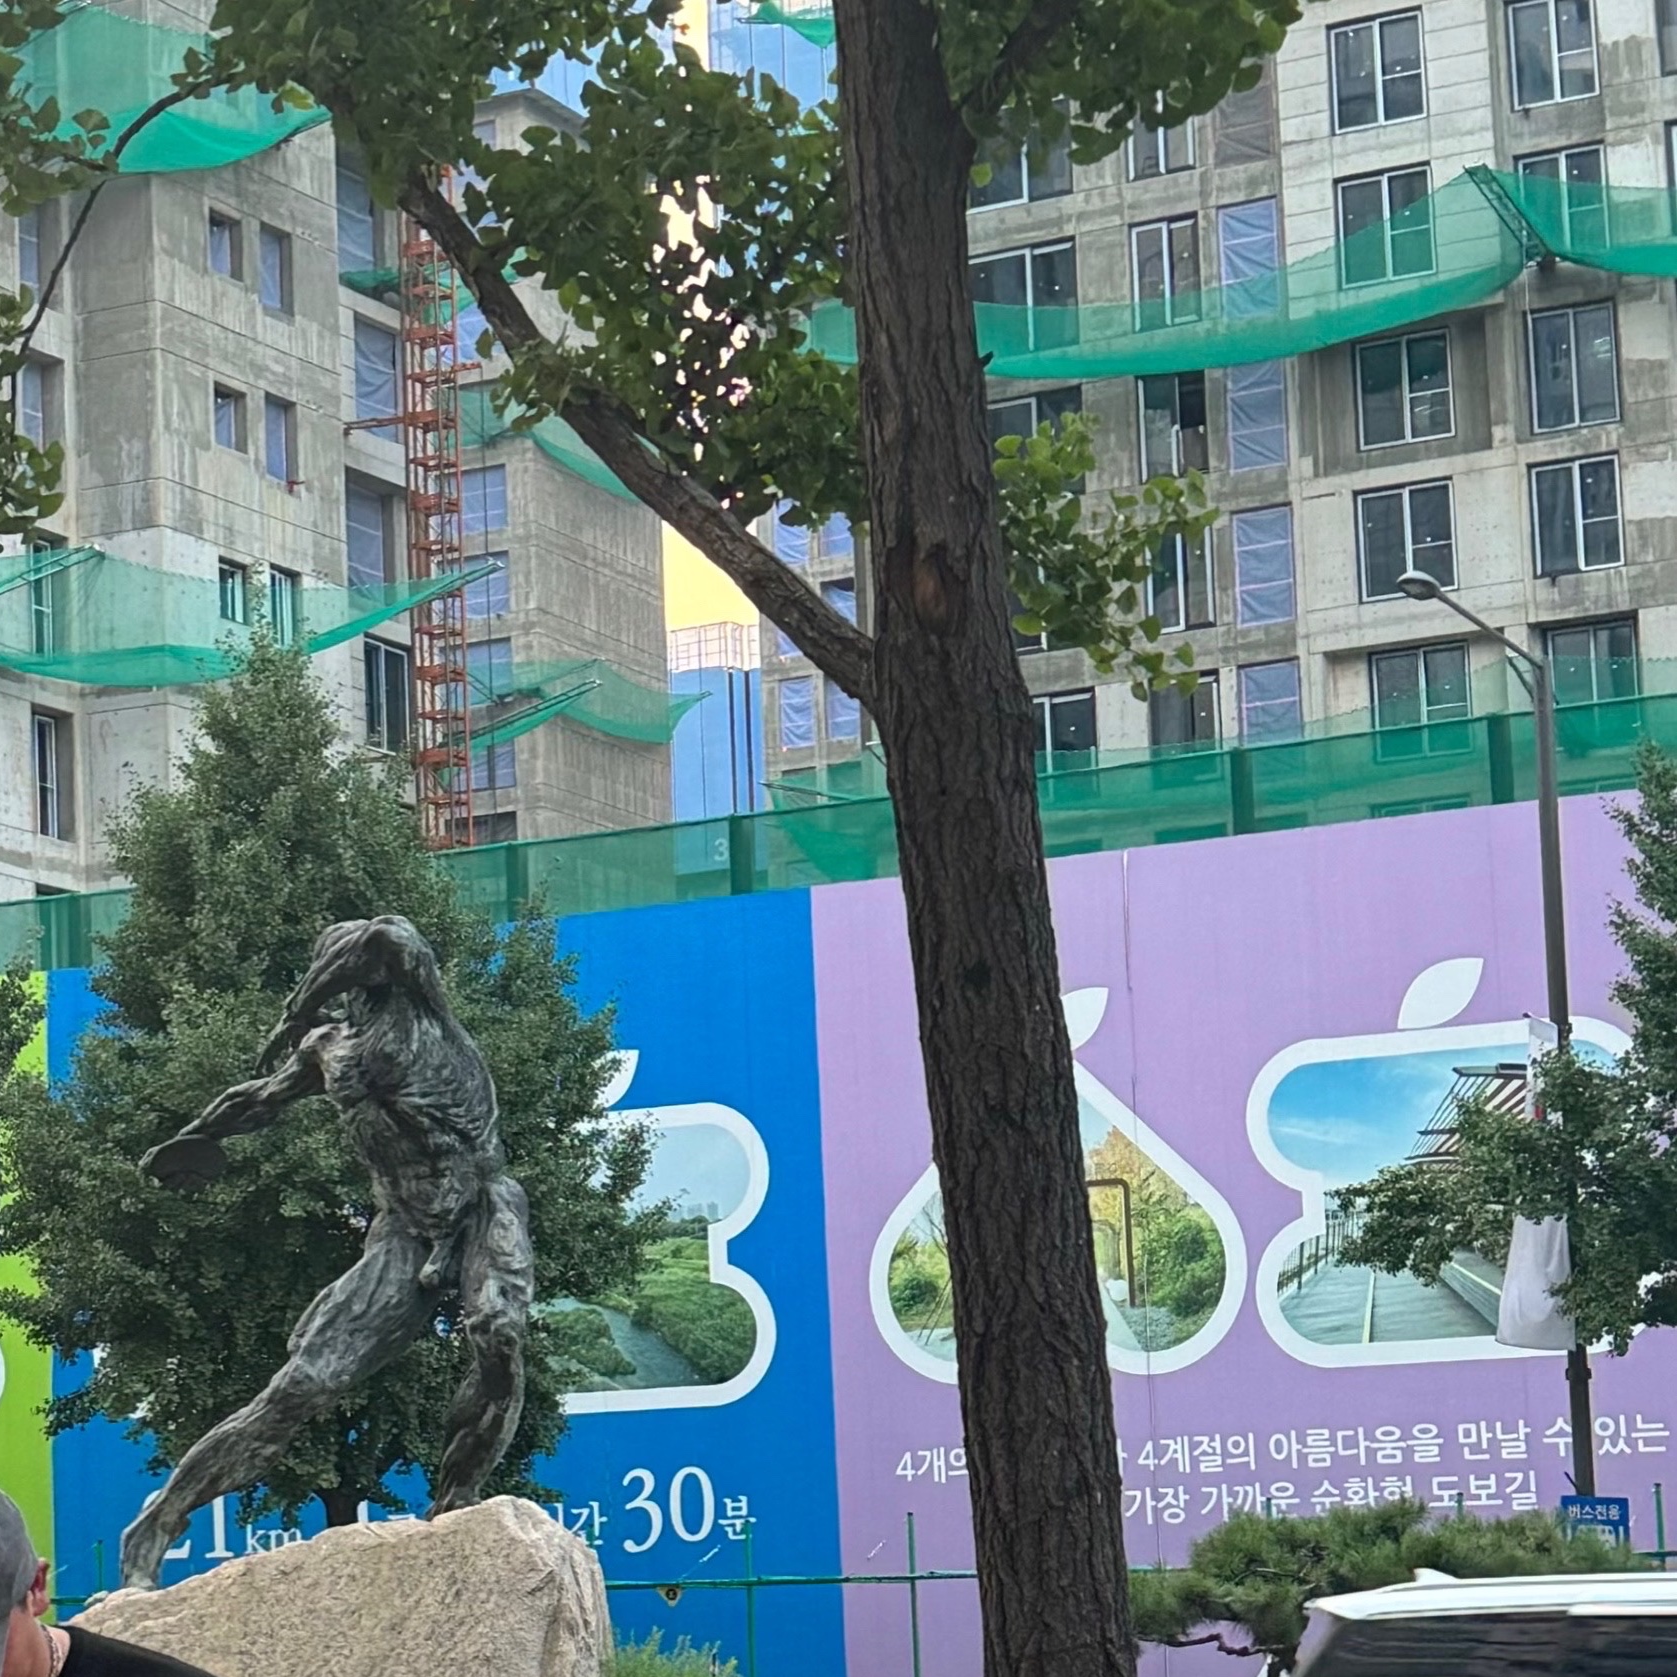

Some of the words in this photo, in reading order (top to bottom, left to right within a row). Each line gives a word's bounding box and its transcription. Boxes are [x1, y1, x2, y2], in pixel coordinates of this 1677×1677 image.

[1137, 1432, 1256, 1473] 4계절의
[1269, 1422, 1444, 1469] 아름다움을
[1457, 1418, 1532, 1461] 만날
[1593, 1413, 1671, 1456] 있는
[1124, 1484, 1190, 1525] 가장
[1200, 1480, 1301, 1523] 가까운
[1428, 1469, 1539, 1511] 도보길
[1568, 1503, 1621, 1520] 버스전용
